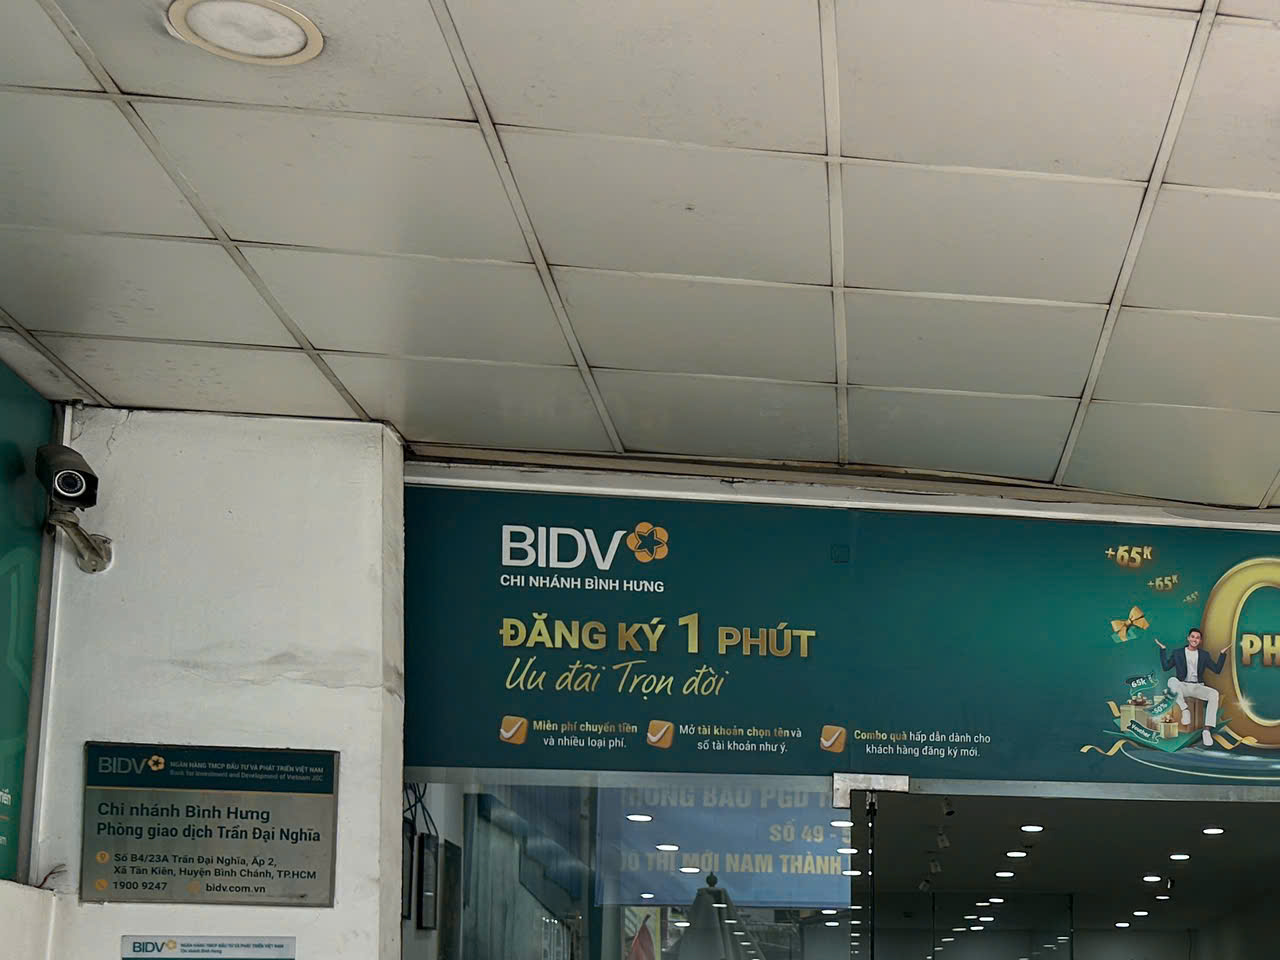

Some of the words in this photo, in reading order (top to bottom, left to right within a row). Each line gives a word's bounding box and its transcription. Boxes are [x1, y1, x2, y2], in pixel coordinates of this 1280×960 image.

[502, 525, 627, 570] BIDV
[500, 574, 526, 587] CHI
[528, 573, 581, 590] NHÁNH
[584, 575, 620, 591] BÌNH
[623, 578, 664, 593] HƯNG
[500, 612, 607, 650] ĐĂNG
[618, 616, 666, 652] KÝ
[678, 612, 700, 654] 1
[718, 623, 817, 658] PHÚT
[554, 663, 606, 693] đãi
[612, 658, 674, 700] Trọn
[681, 663, 728, 697] đời
[561, 720, 577, 734] phí
[679, 724, 695, 735] Mở
[697, 725, 711, 736] tài
[746, 726, 770, 739] chọn
[543, 736, 554, 746] và
[588, 736, 606, 749] loại
[609, 737, 627, 751] phí.
[697, 738, 709, 750] số
[712, 739, 724, 750] tài
[727, 739, 757, 752] khoản
[759, 740, 778, 752] như
[854, 729, 888, 741] Combo
[889, 730, 907, 744] quà
[909, 730, 927, 745] hấp
[948, 731, 971, 743] dành
[973, 732, 991, 744] cho
[866, 743, 894, 755] khách
[896, 744, 919, 758] hàng
[921, 744, 945, 758] đăng
[947, 744, 959, 758] ký
[960, 745, 981, 757] mới.
[98, 757, 148, 774] BIDV
[97, 802, 125, 816] Chi
[129, 801, 180, 818] nhánh
[185, 803, 221, 820] Bình
[226, 806, 270, 823] Hưng
[97, 822, 143, 840] Phòng
[147, 824, 178, 841] giao
[182, 824, 213, 841] dịch
[217, 824, 248, 840] Trần
[252, 826, 275, 843] Đại
[279, 827, 321, 844] Nghĩa
[130, 853, 169, 864] B4/23A
[197, 854, 214, 866] Đại
[217, 856, 249, 868] Nghĩa,
[725, 853, 773, 874] NAM
[779, 853, 841, 875] THÀNH
[151, 865, 177, 878] Kiên,
[179, 866, 212, 881] Huyện
[214, 867, 237, 878] Bình
[239, 867, 274, 881] Chánh,
[276, 869, 317, 880] TP.HCM
[113, 881, 139, 891] 1900
[141, 881, 168, 891] 9247
[205, 882, 266, 894] bidv.com.vn
[132, 941, 165, 953] BIDV
